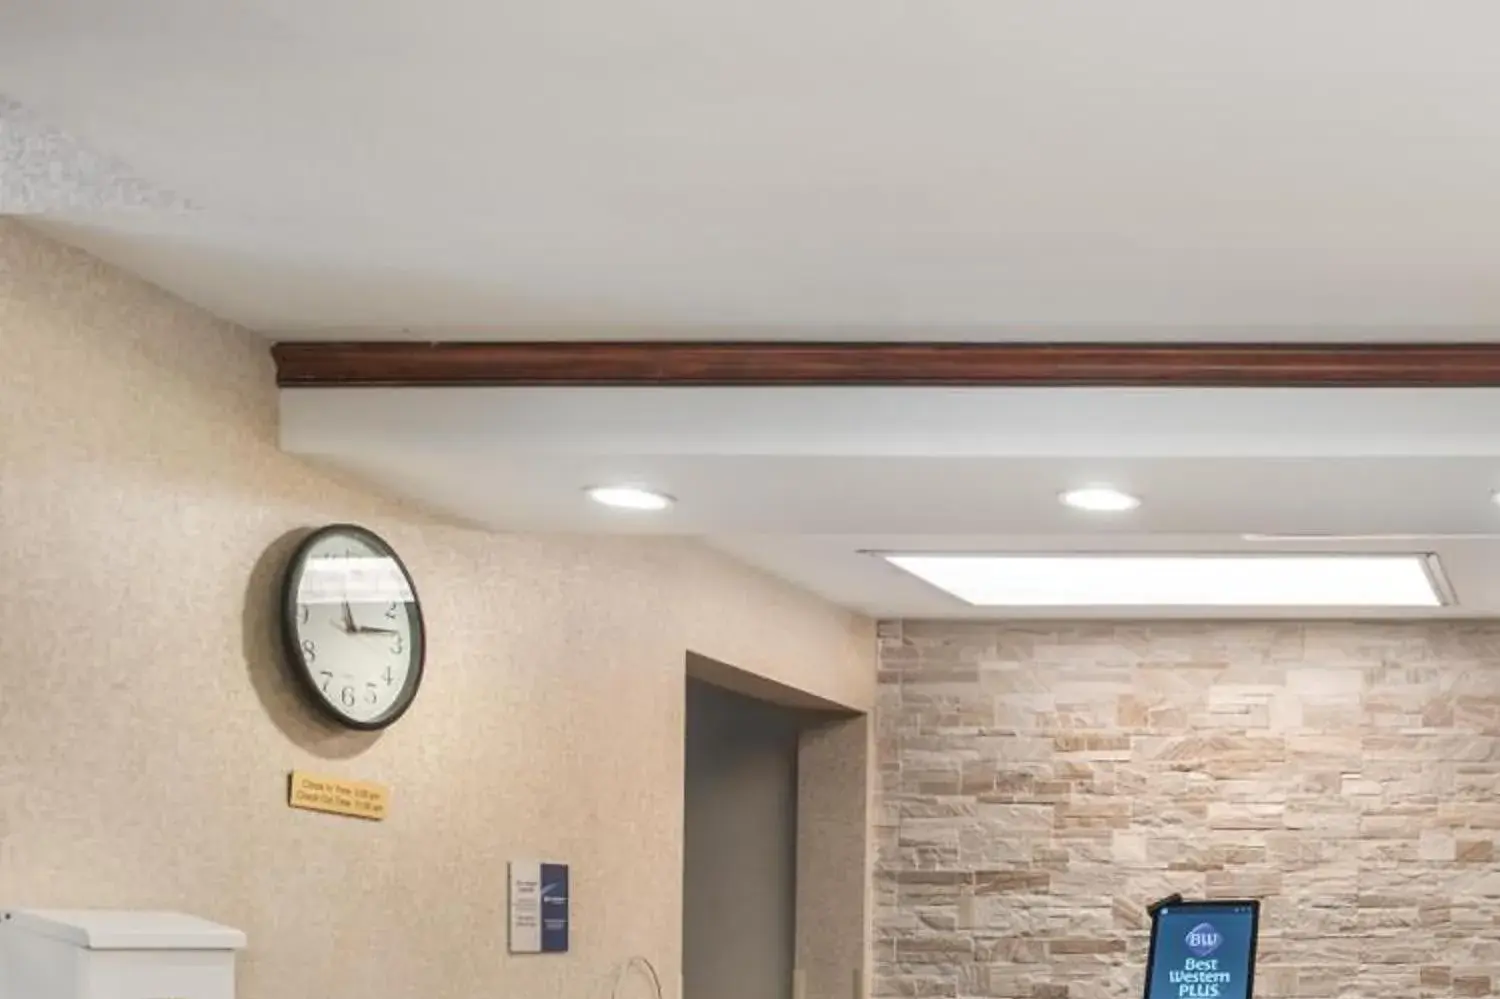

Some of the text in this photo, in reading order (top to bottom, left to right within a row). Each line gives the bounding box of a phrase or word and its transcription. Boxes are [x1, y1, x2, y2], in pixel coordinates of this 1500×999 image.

[385, 602, 398, 620] 2
[302, 639, 316, 663] 8
[319, 670, 334, 692] 7
[380, 665, 394, 686] 4
[341, 685, 355, 707] 6
[363, 682, 377, 704] 5
[1189, 933, 1217, 947] BW
[1185, 958, 1218, 971] Best
[1168, 971, 1231, 983] Western
[1179, 983, 1219, 997] PLUS
